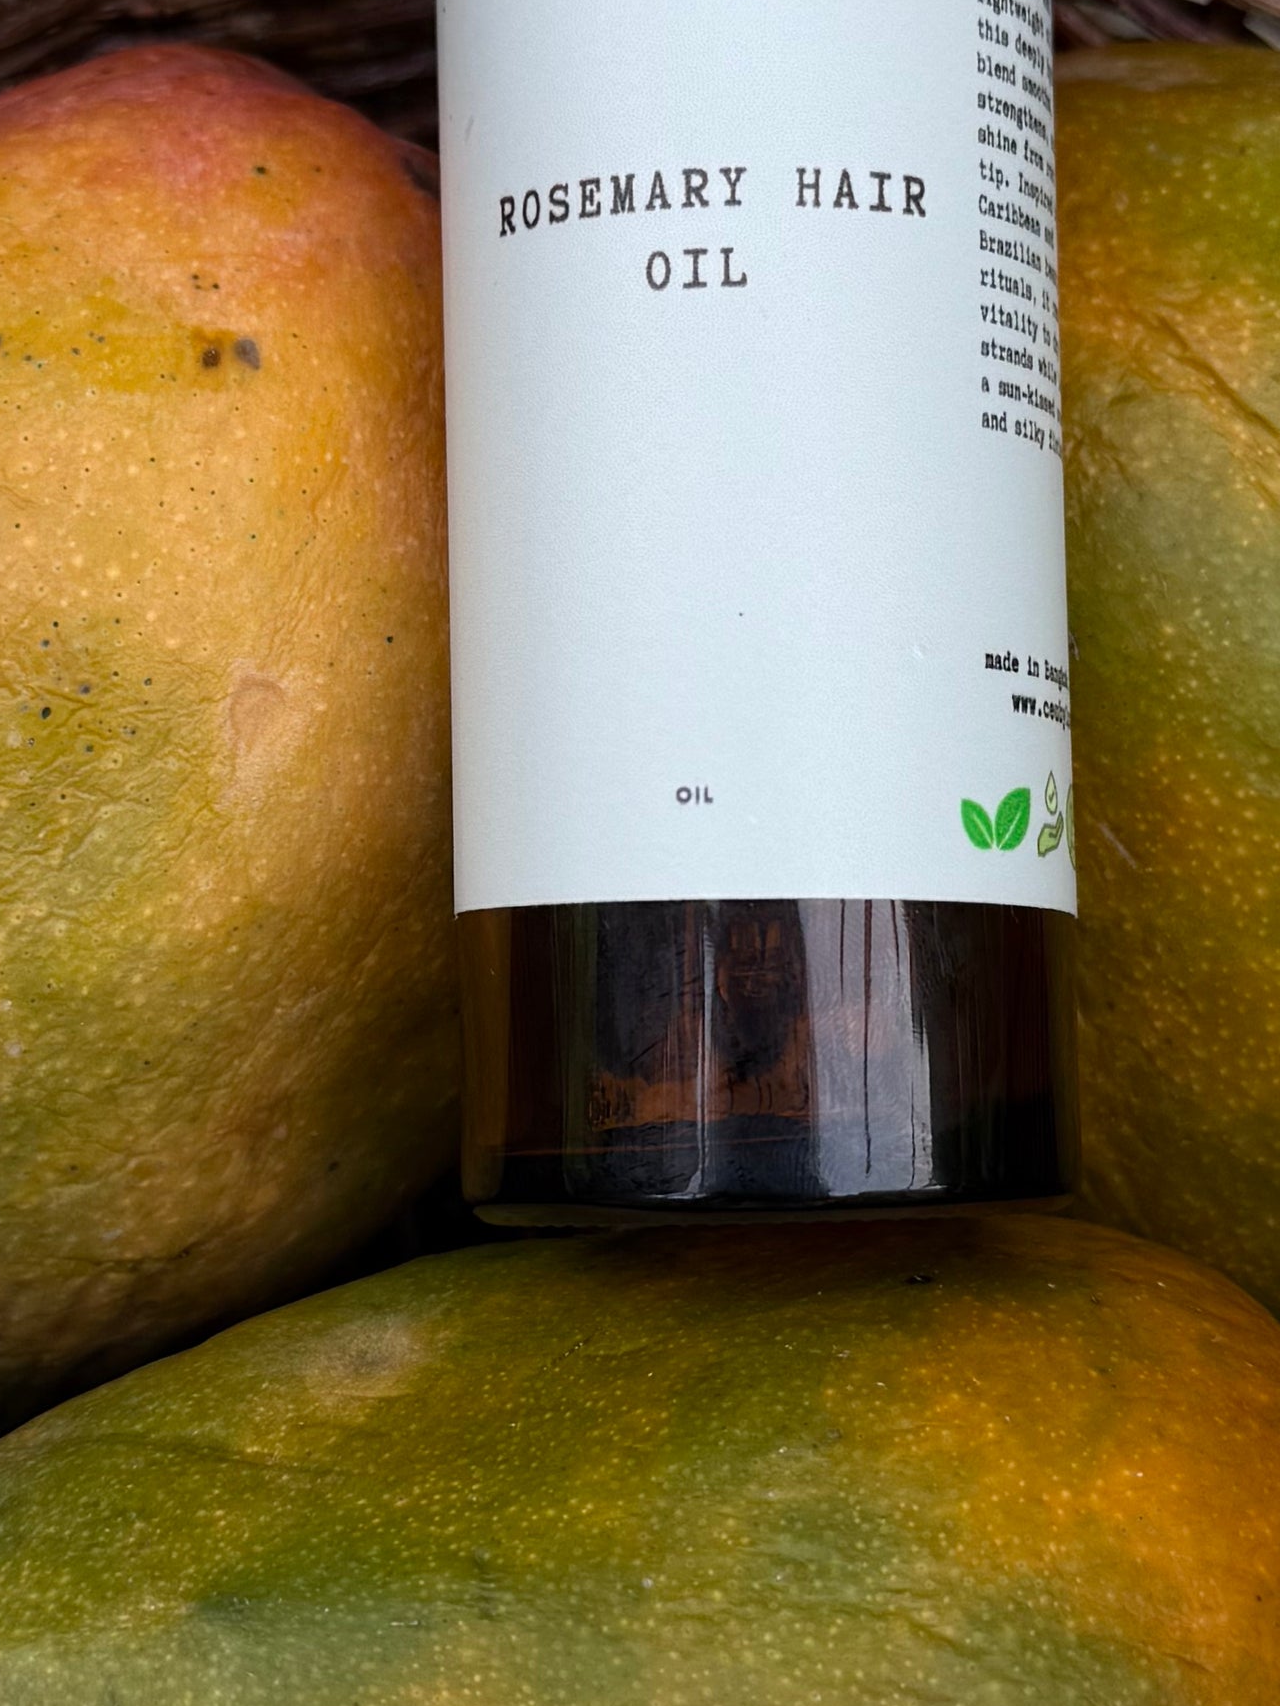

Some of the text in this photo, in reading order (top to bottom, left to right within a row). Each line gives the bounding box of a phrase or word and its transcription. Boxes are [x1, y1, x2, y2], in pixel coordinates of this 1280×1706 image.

[978, 18, 1009, 47] this
[977, 52, 1016, 86] blend
[978, 125, 1017, 155] shine
[979, 158, 1009, 190] tip.
[500, 167, 926, 237] ROSEMARY HAIR
[979, 194, 1040, 237] Caribbean
[979, 229, 1041, 272] Brazilian
[646, 247, 748, 291] OIL
[980, 267, 1036, 307] rituals,
[980, 303, 1038, 343] vitality
[980, 338, 1033, 370] strands
[981, 376, 990, 393] a
[981, 411, 1008, 433] and
[1015, 418, 1045, 450] silky
[985, 650, 1019, 673] made
[1028, 656, 1040, 678] in
[676, 785, 713, 805] OIL
